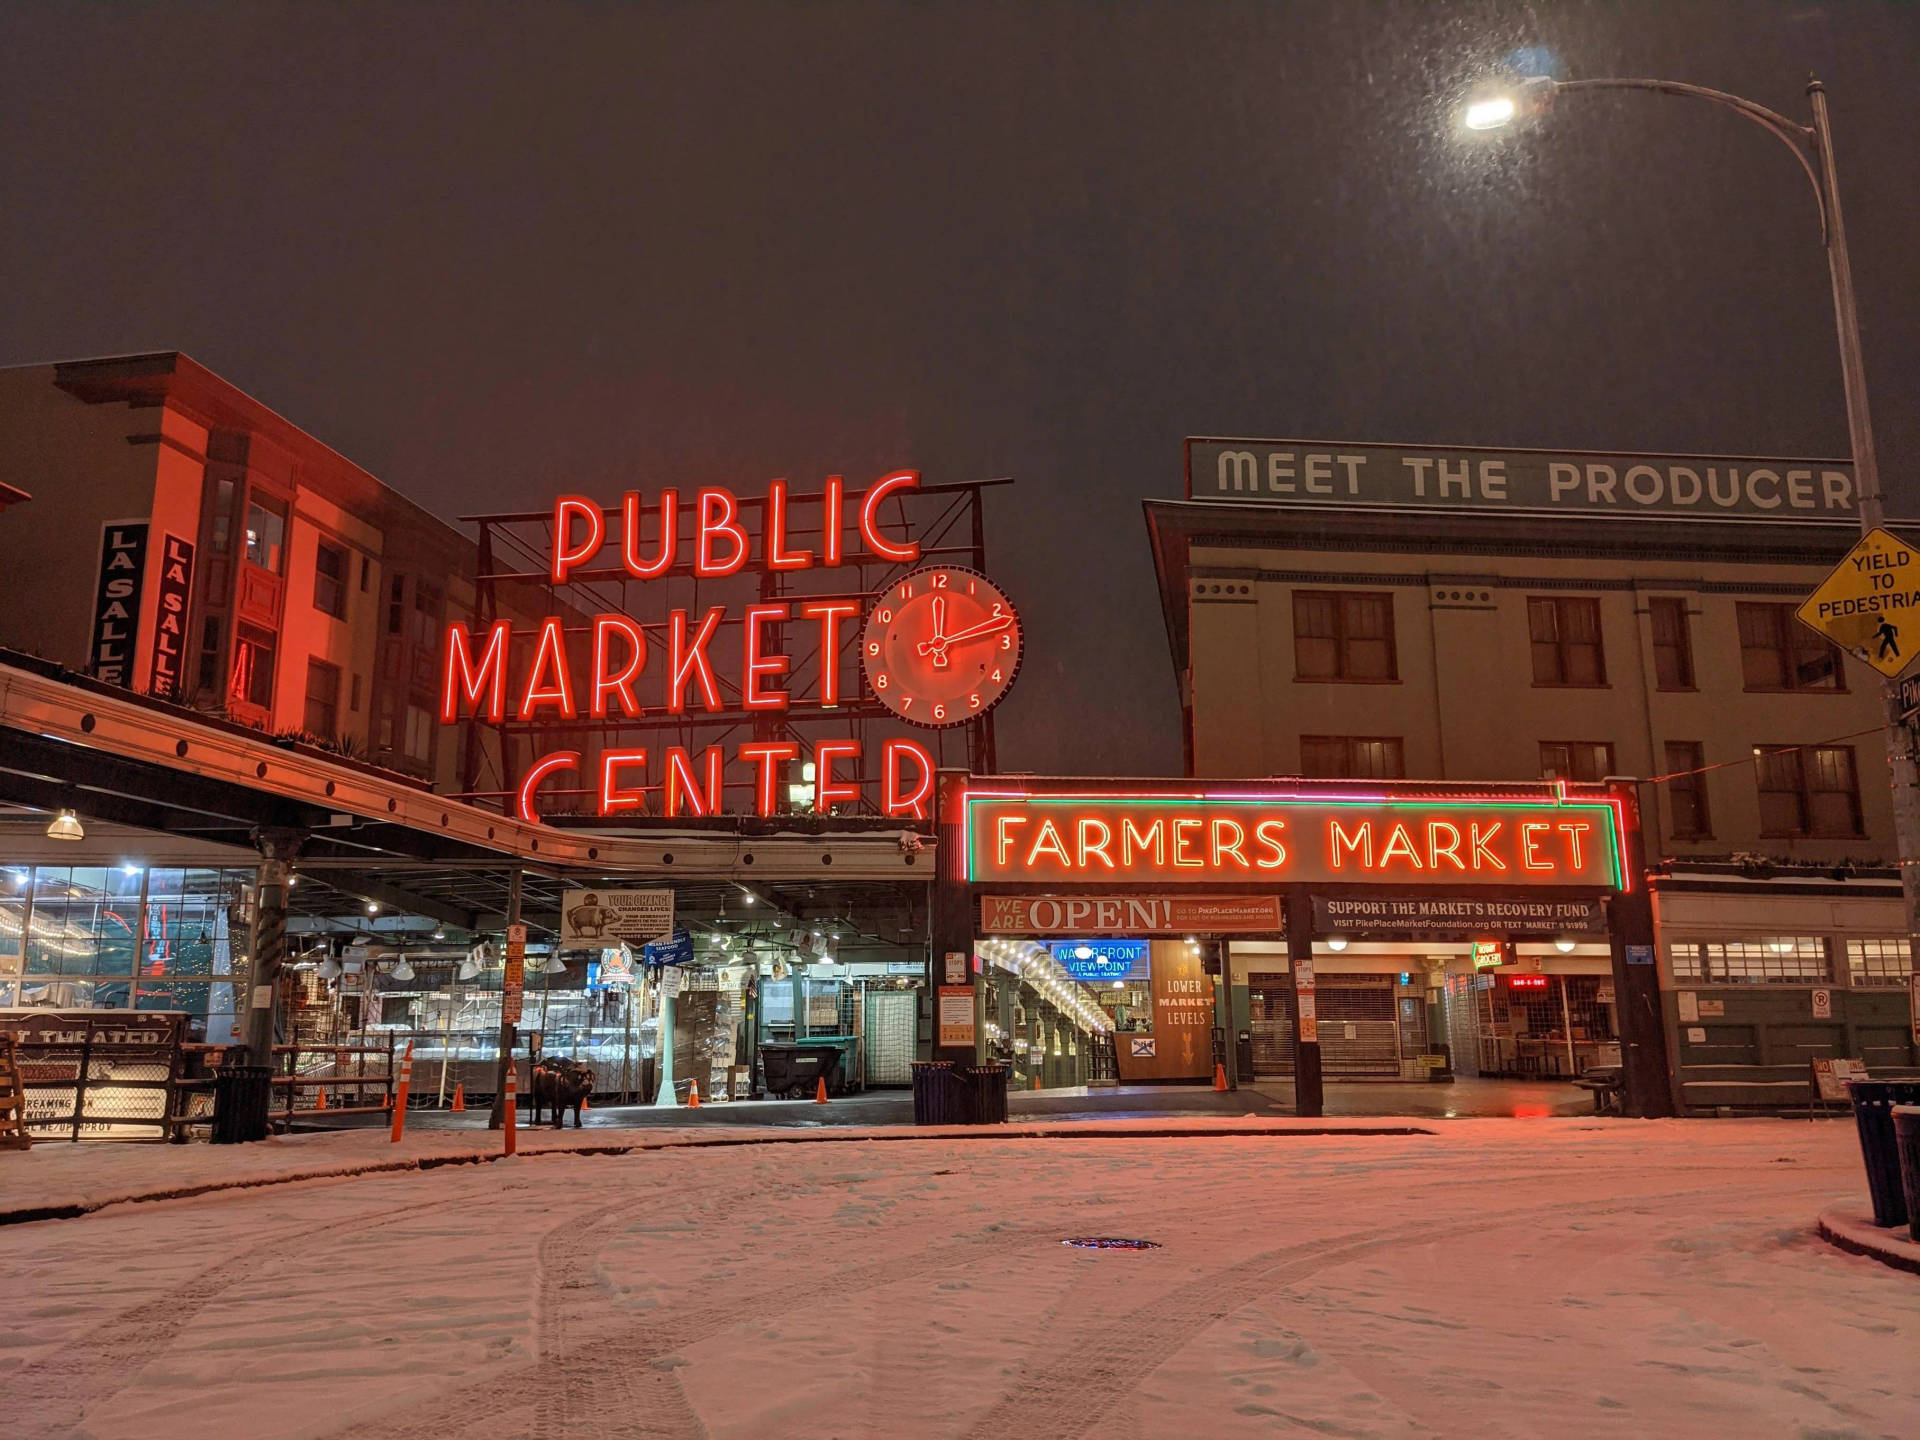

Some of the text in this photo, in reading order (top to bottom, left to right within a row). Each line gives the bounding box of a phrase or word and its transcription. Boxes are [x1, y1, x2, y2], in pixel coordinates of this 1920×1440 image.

[1216, 450, 1852, 510] MEET THE PRODUCER
[551, 468, 921, 585] PUBLIC
[1851, 550, 1910, 572] YIELD
[932, 575, 947, 588] 12
[970, 581, 975, 595] 1
[1870, 573, 1895, 591] TO
[901, 585, 912, 599] 11
[97, 531, 137, 687] LA SALLE
[992, 603, 1002, 617] 2
[1818, 590, 1920, 618] PEDESTRIA
[154, 540, 188, 696] LA SALLE
[878, 610, 892, 623] 10
[869, 643, 880, 656] 9
[1001, 635, 1011, 650] 3
[440, 600, 862, 725] MARKET
[877, 675, 888, 688] 8
[991, 669, 1002, 682] 4
[902, 697, 913, 711] 7
[970, 694, 980, 708] 5
[934, 704, 945, 719] 6
[517, 738, 937, 821] CENTER
[998, 816, 1590, 870] FARMERS MARKET
[608, 894, 671, 907] YOUR CHANGE
[995, 900, 1023, 912] WE
[990, 899, 1172, 929] ARE OPEN!
[1327, 901, 1590, 917] SUPPORT THE MARKET'S RECOVERY FUND
[1333, 919, 1353, 927] VISIT
[1355, 919, 1489, 930] PikePlaceMarketFoundation.org
[1490, 920, 1502, 929] OR
[1504, 920, 1521, 929] TEXT
[1069, 961, 1132, 972] VIEWPOINT
[1167, 980, 1202, 993] LOWER
[1159, 998, 1212, 1007] MARKET
[1167, 1012, 1206, 1025] LEVELS
